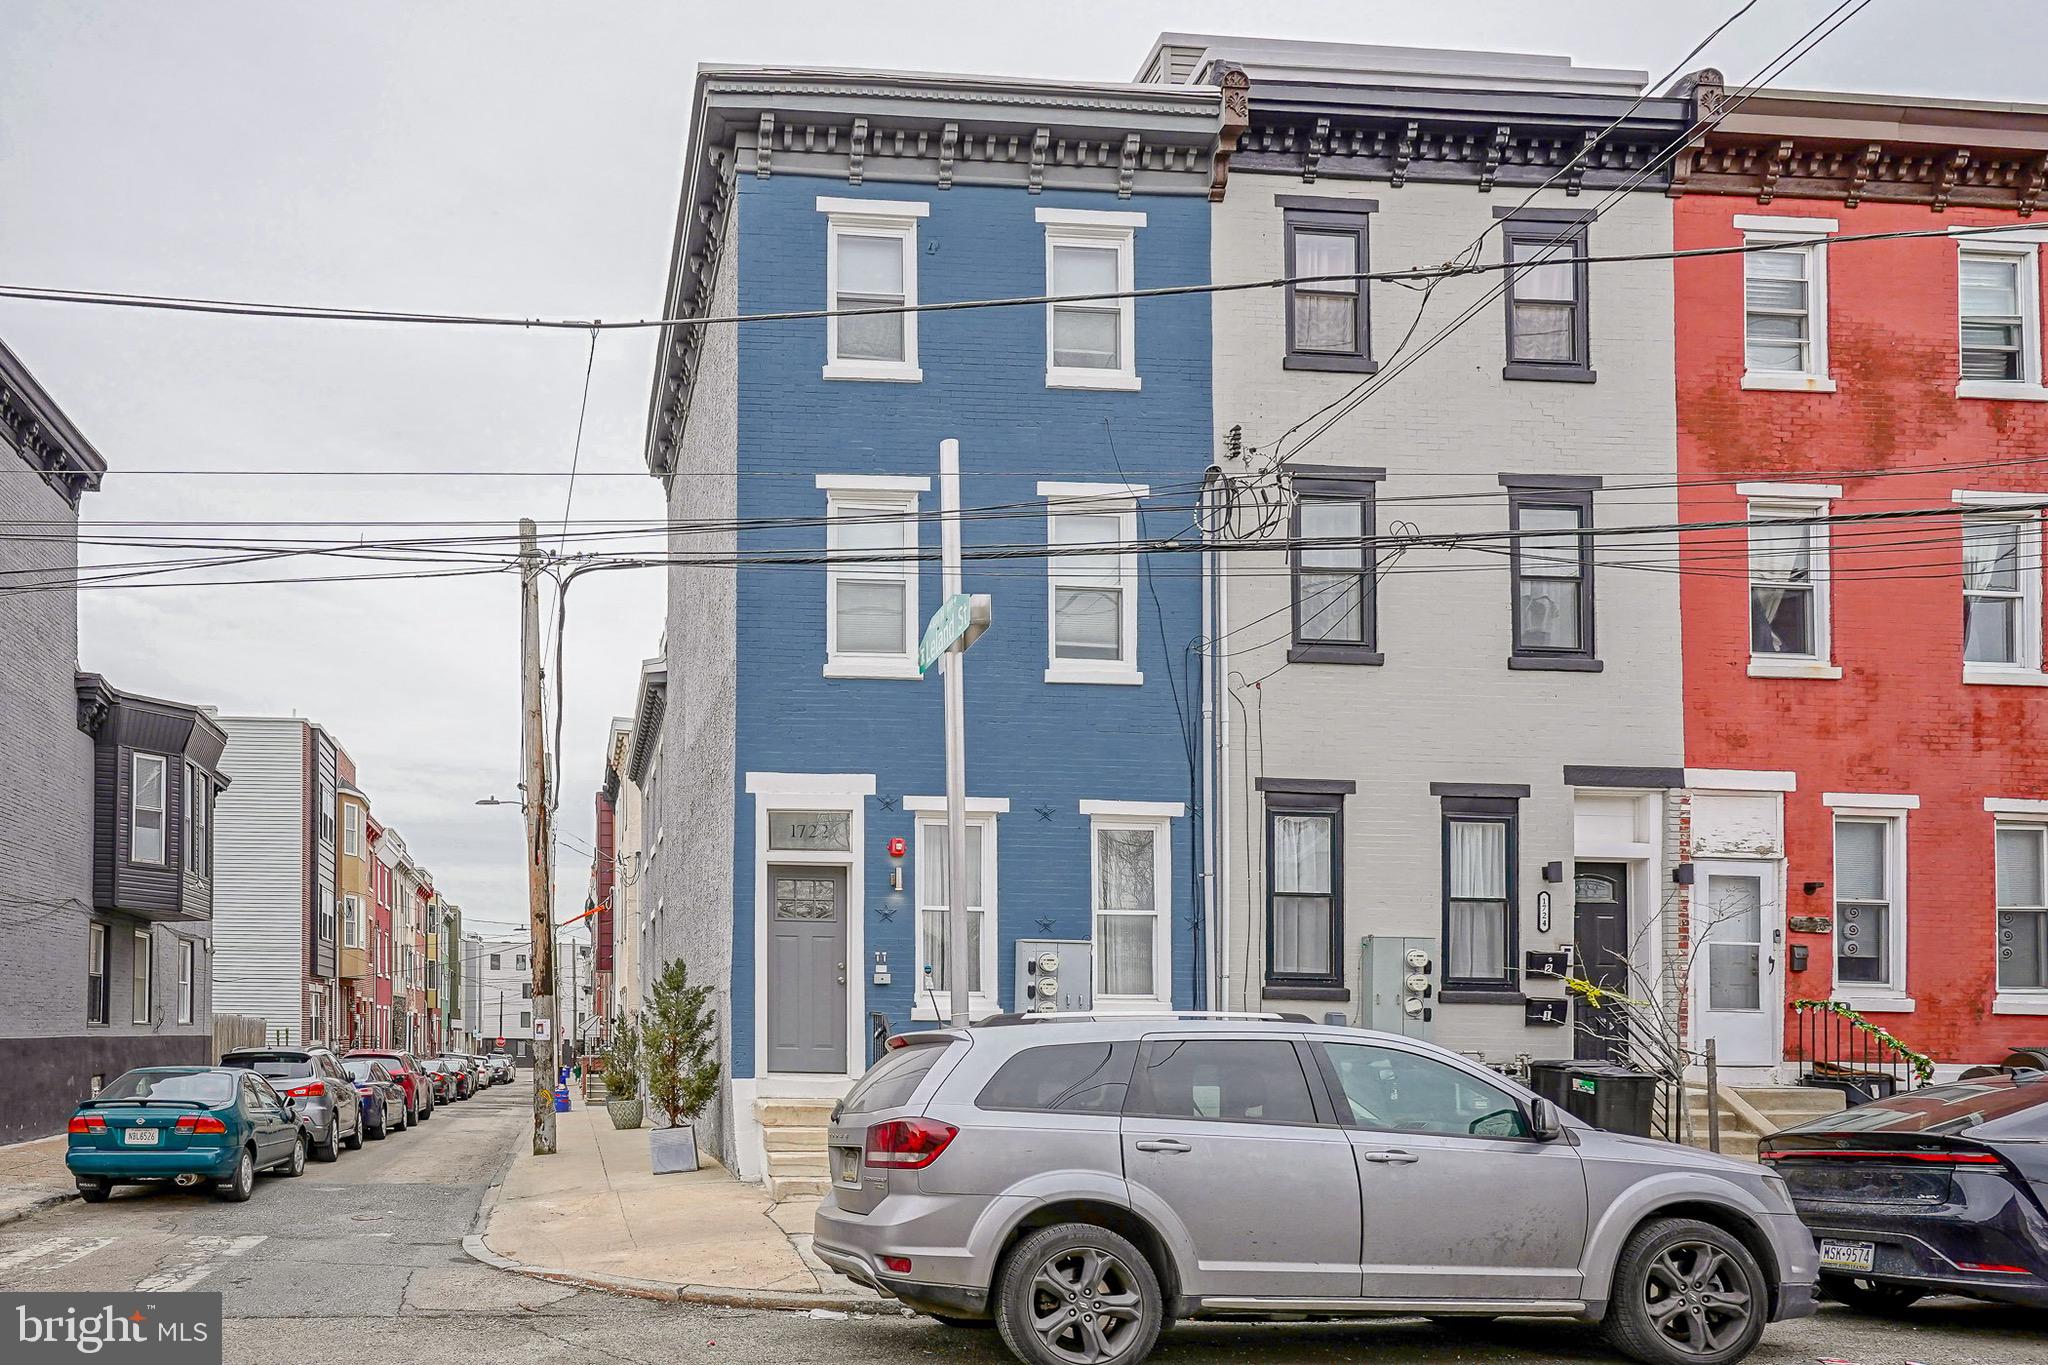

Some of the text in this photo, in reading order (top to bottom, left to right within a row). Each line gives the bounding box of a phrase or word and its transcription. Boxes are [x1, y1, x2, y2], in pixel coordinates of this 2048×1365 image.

[926, 612, 955, 662] Leland
[958, 603, 968, 630] St
[790, 824, 829, 839] 1722
[1545, 964, 1552, 972] 2
